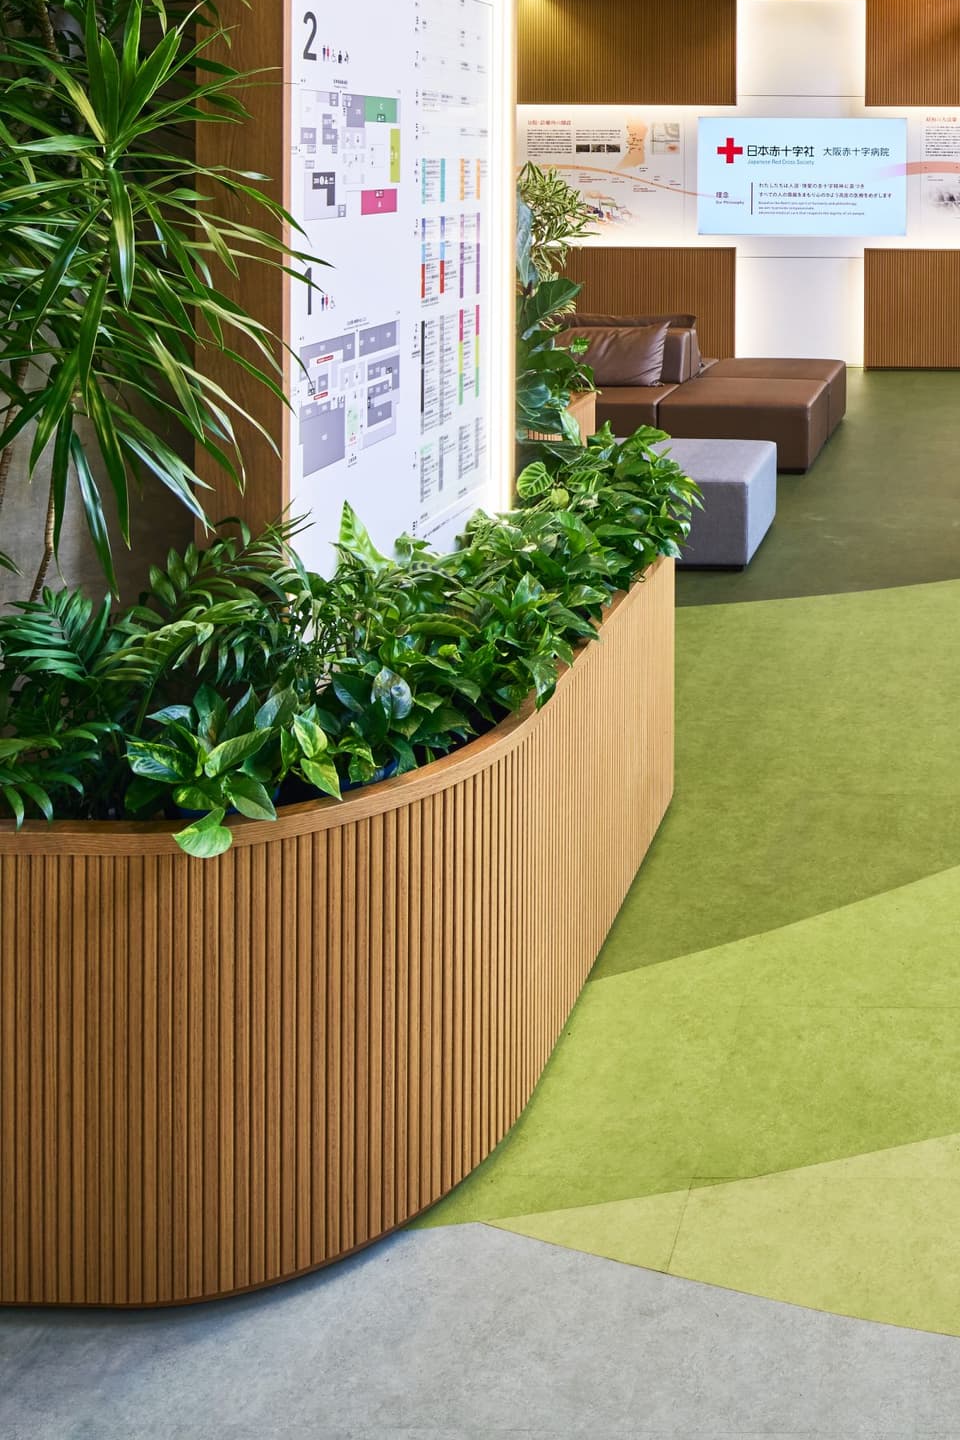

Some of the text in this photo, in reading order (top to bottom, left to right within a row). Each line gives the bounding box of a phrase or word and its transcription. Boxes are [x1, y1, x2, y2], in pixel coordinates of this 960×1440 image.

[303, 11, 317, 61] 2
[747, 144, 890, 158] 日本赤十字社 大阪赤十字病院
